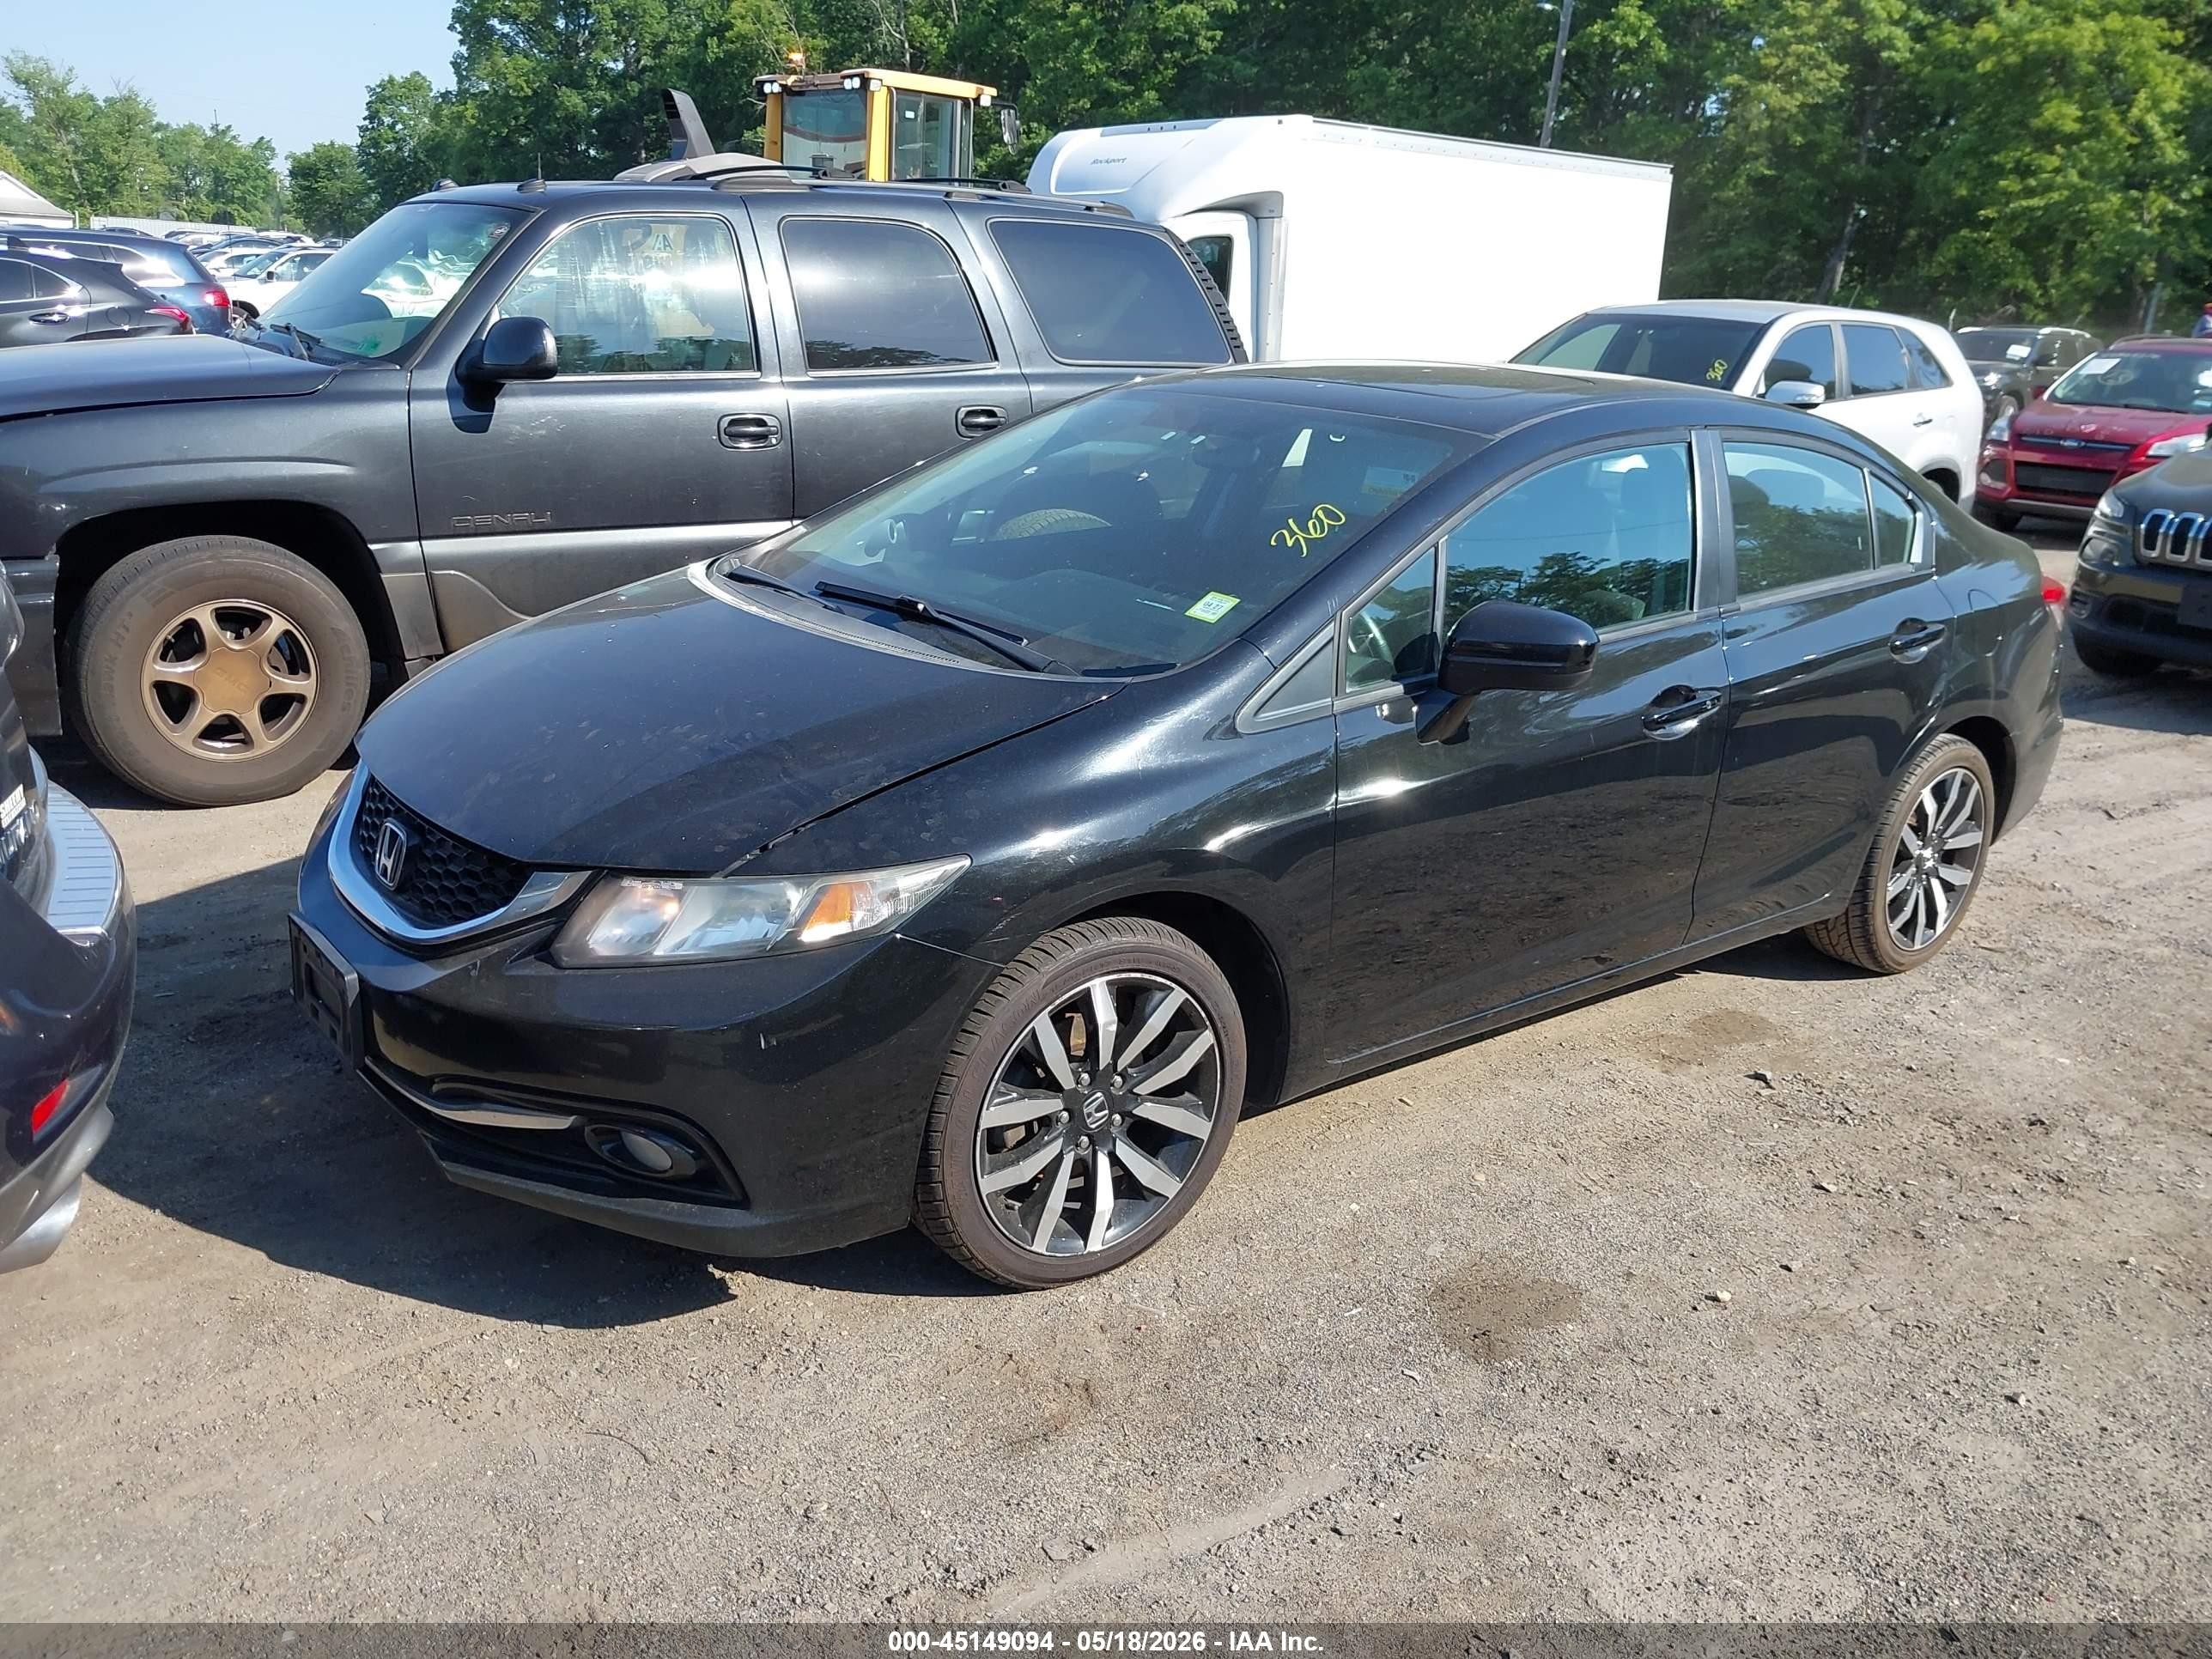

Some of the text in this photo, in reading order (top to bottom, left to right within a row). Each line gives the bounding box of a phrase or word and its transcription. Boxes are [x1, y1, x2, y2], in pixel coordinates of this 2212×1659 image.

[1705, 359, 1729, 381] 360
[452, 512, 551, 527] DENALI
[1270, 503, 1346, 557] 360
